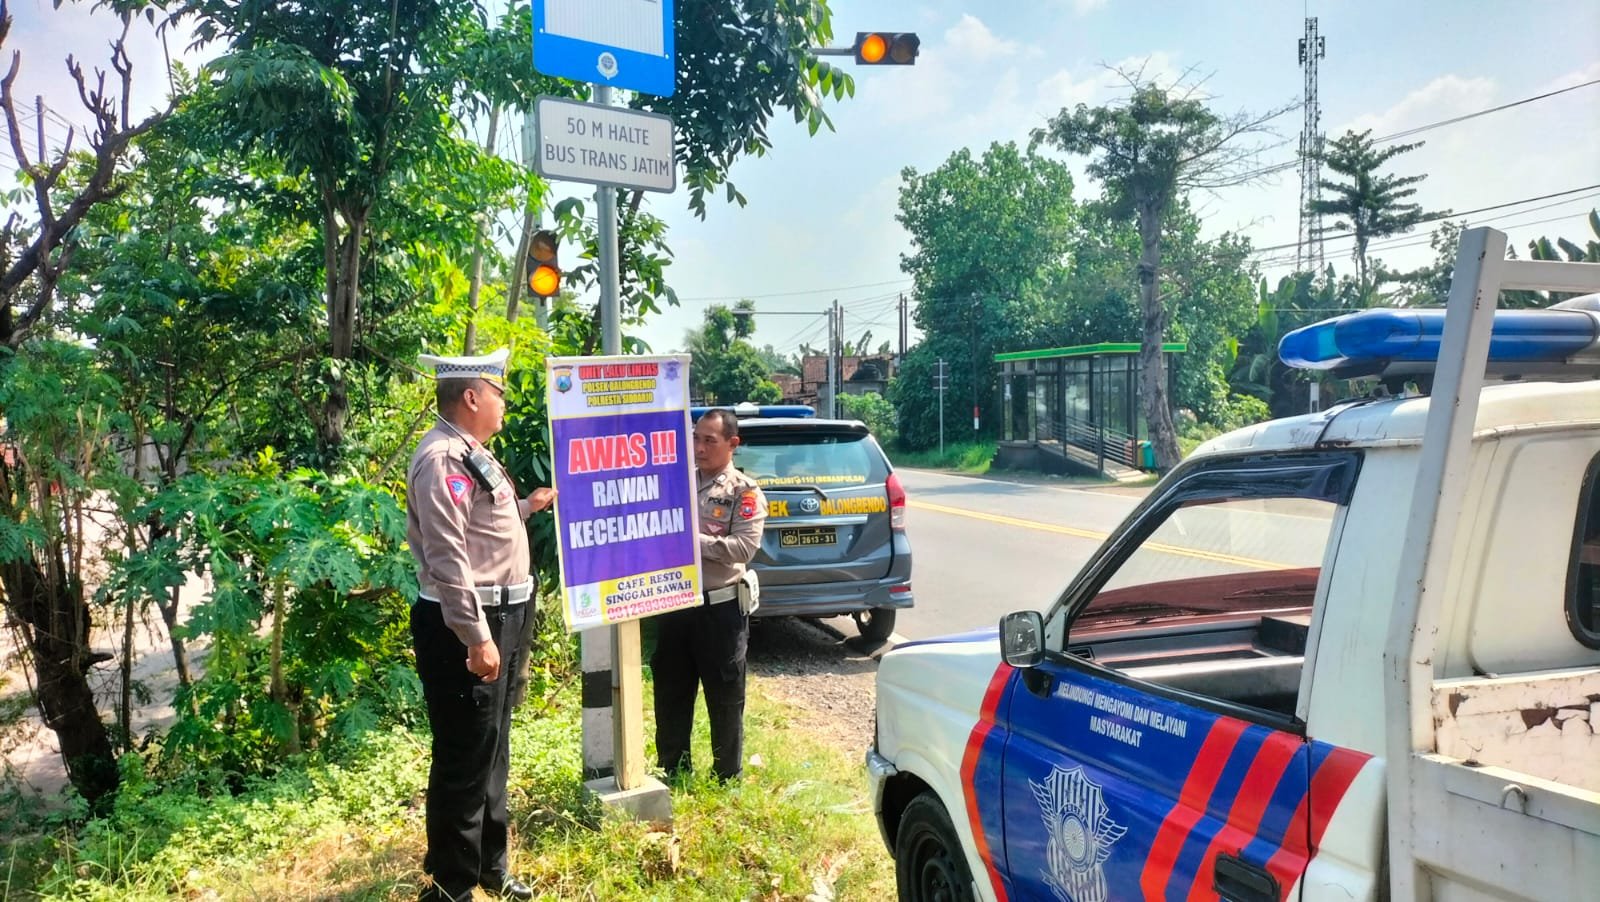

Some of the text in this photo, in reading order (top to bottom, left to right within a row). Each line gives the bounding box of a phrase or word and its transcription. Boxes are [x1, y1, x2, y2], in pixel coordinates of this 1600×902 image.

[567, 117, 649, 146] 50 M HALTE
[545, 143, 669, 177] BUS TRANS JATIM
[568, 430, 677, 474] AWAS !!!
[592, 474, 660, 507] RAWAN
[820, 496, 886, 516] BALONGBENDO
[569, 507, 685, 549] KECELAKAAN
[606, 580, 692, 606] SINGGAH SAWAH
[617, 570, 683, 591] CAFE RESTO
[1058, 681, 1187, 739] MELINDUNGI MENGAYOMI DAN MELAYANI
[1089, 715, 1142, 748] MASYARAKAT
